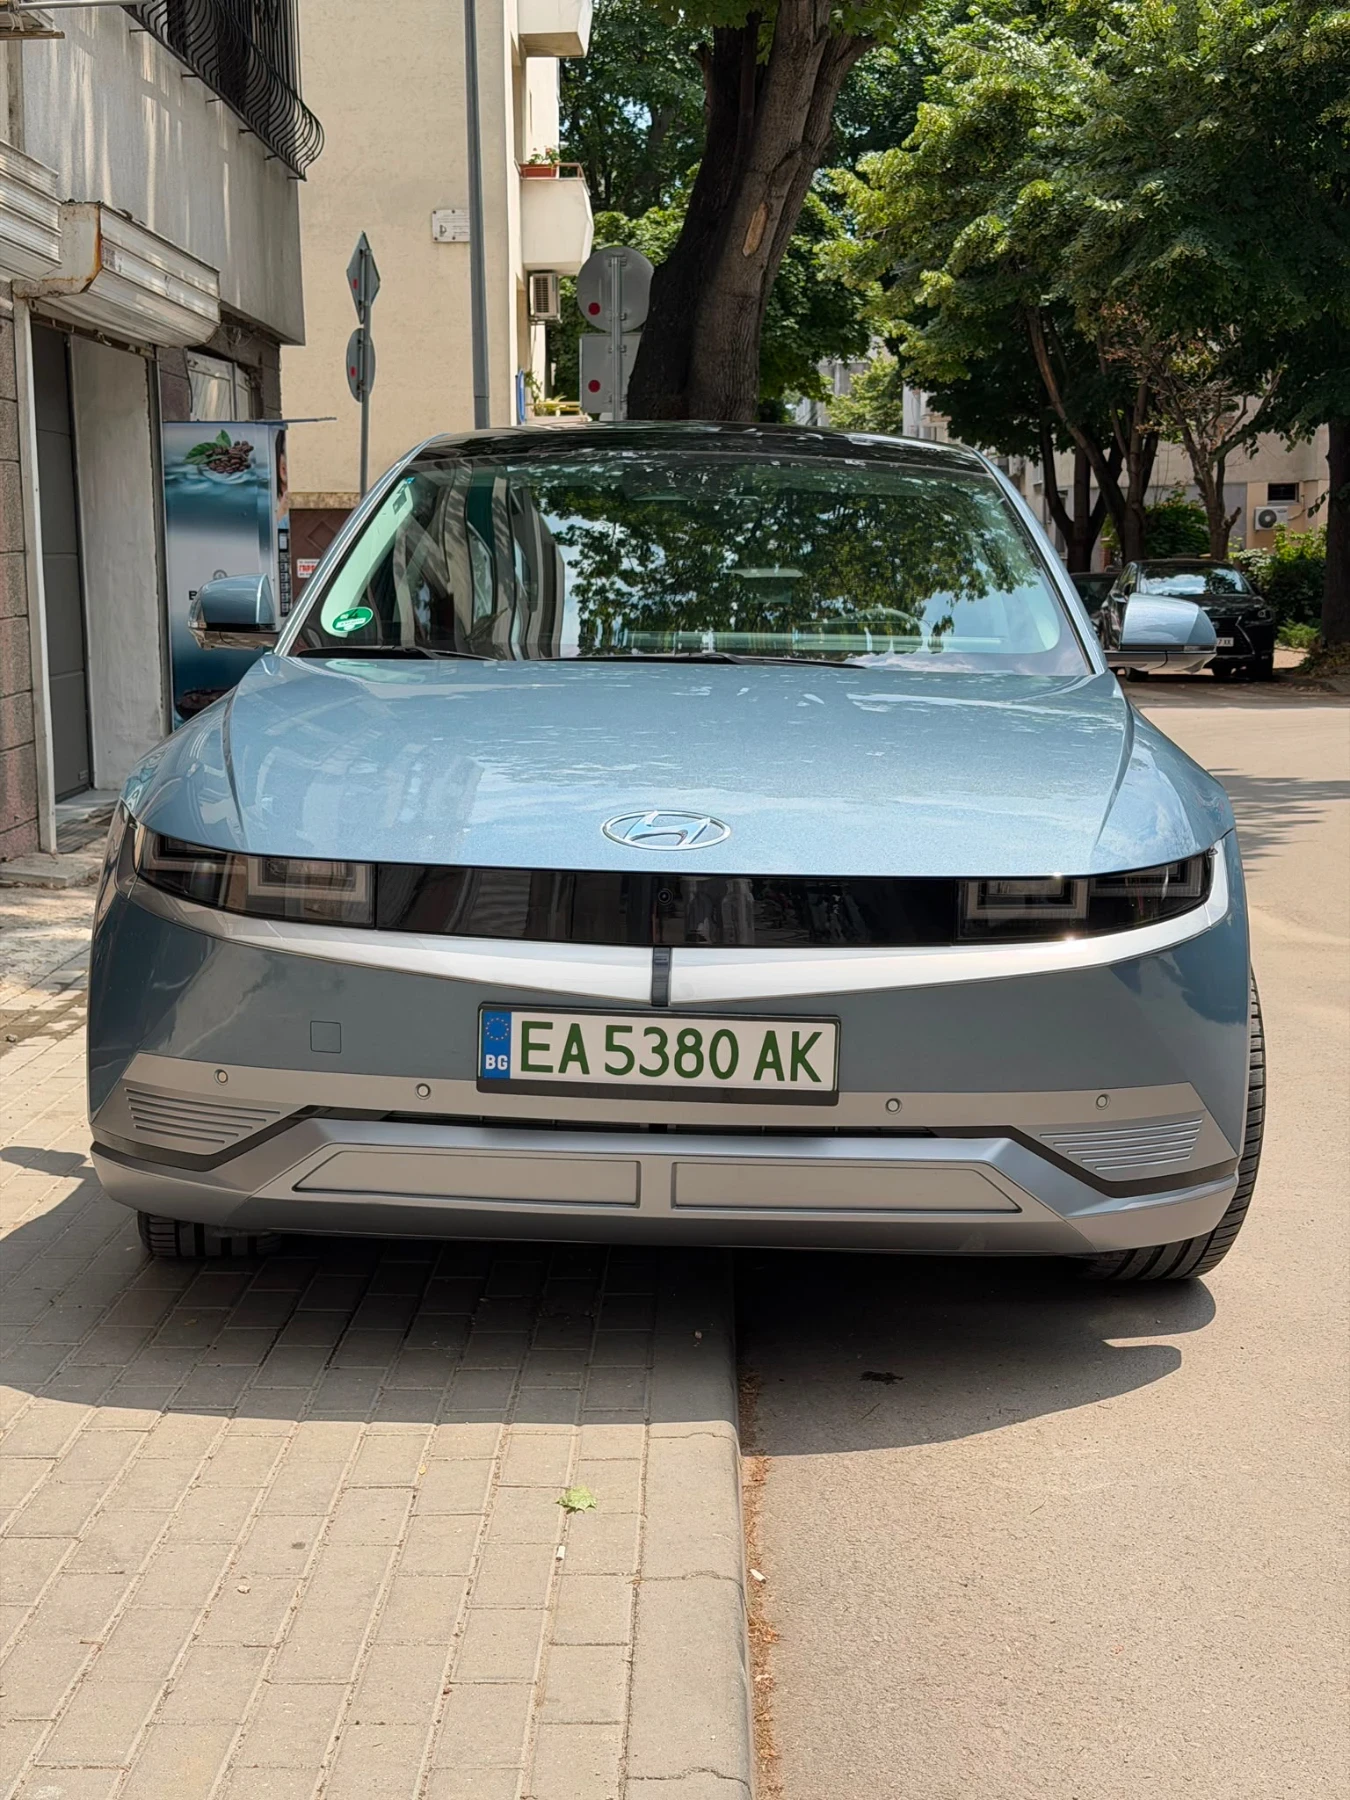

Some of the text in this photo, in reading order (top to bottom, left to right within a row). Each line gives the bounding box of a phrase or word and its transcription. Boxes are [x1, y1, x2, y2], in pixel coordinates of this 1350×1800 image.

[485, 1054, 508, 1070] BG
[520, 1020, 823, 1083] EA 5380 AK
